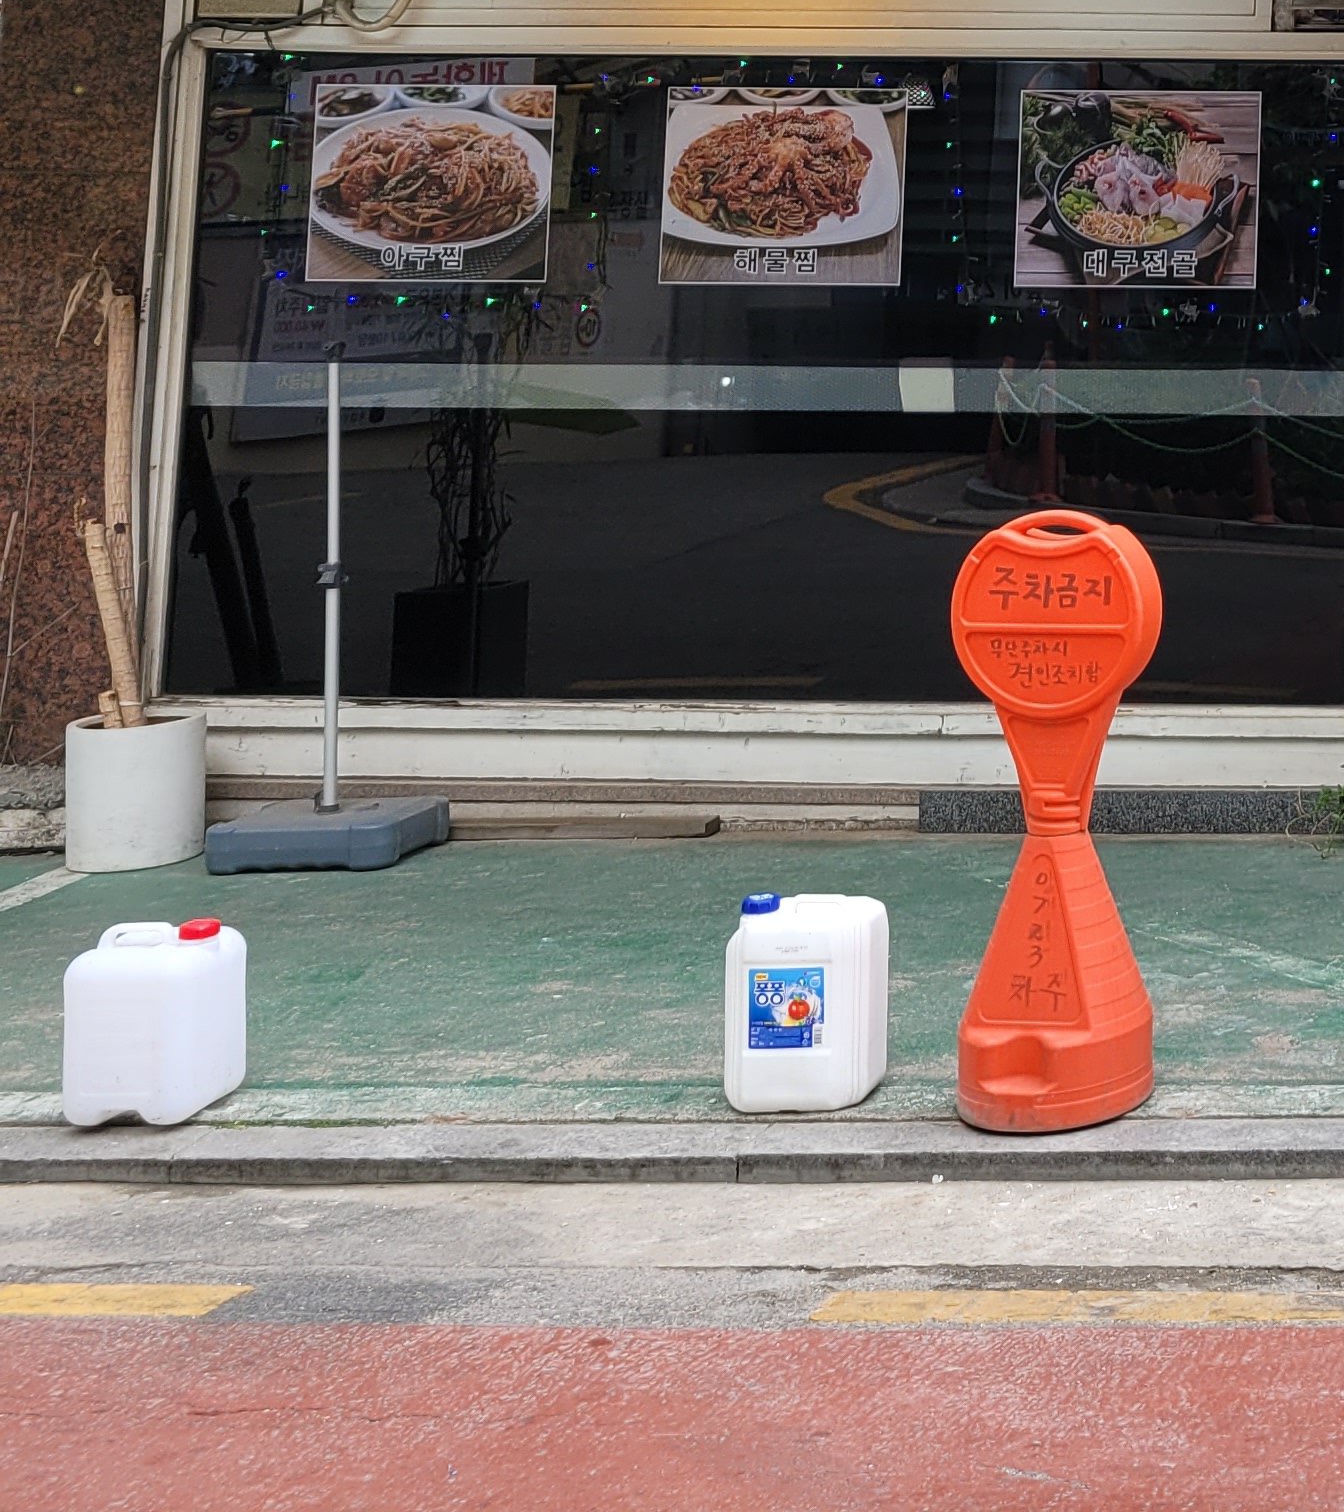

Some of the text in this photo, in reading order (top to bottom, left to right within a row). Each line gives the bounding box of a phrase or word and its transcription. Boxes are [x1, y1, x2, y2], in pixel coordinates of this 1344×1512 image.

[380, 244, 464, 271] 아구찜
[733, 248, 818, 274] 해물찜
[1084, 248, 1199, 277] 대구전골
[988, 566, 1112, 611] 주차금지
